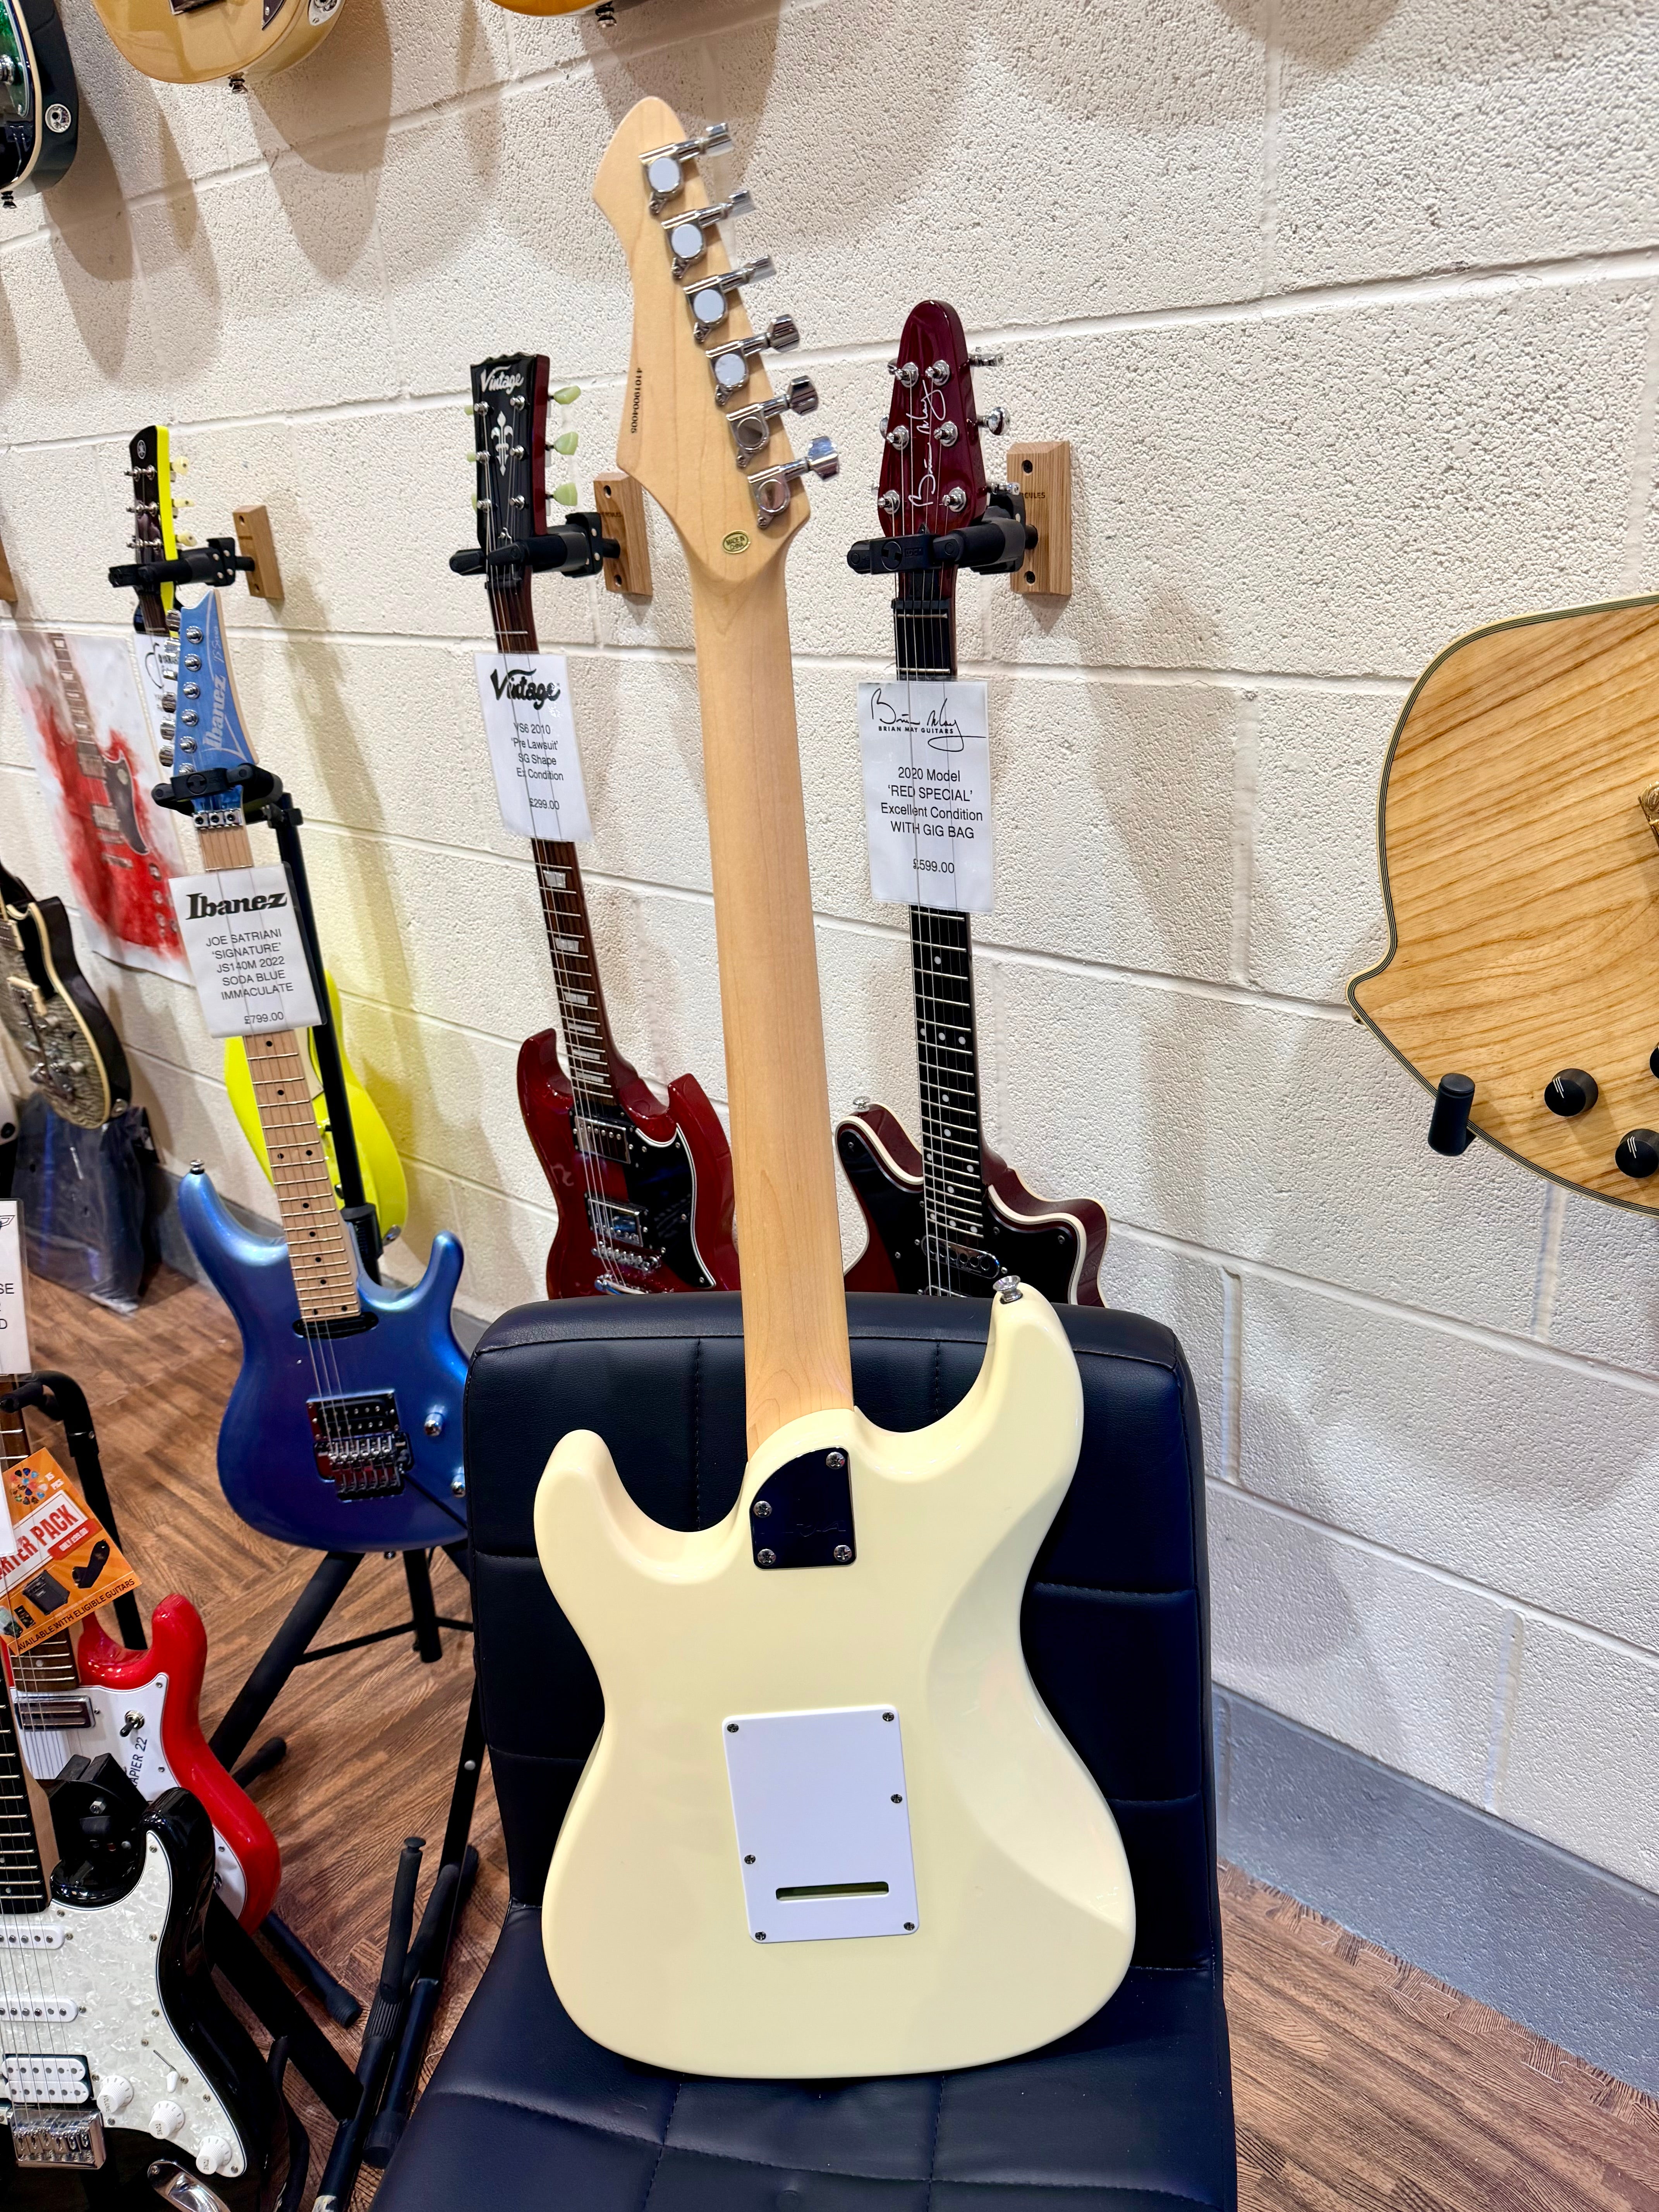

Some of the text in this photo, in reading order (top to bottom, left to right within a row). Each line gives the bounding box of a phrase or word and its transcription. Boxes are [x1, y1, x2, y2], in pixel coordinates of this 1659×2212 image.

[481, 365, 524, 394] Vintage
[490, 668, 561, 710] Vintage
[203, 675, 226, 751] Ibanez
[530, 724, 551, 735] 2010
[518, 753, 556, 765] SG Shape
[528, 769, 564, 781] Condition
[898, 767, 961, 782] 2020 Model
[529, 798, 560, 810] £299.00
[881, 803, 983, 821] Excellent Condition
[891, 821, 974, 839] WITH GIG BAG
[913, 858, 955, 873] £599.00
[185, 892, 288, 920] Ibanez
[206, 928, 282, 947] JOE SATRIANI
[216, 957, 285, 973] JS140M 2022
[222, 970, 286, 986] SODA BLUE
[221, 982, 294, 1000] IMMACULATE
[244, 1011, 284, 1025] £799.00
[30, 1504, 79, 1547] PACK
[18, 1578, 135, 1650] AVAILABLE WITH ELIGIBLE GUITARS
[129, 1737, 147, 1787] APIER 22
